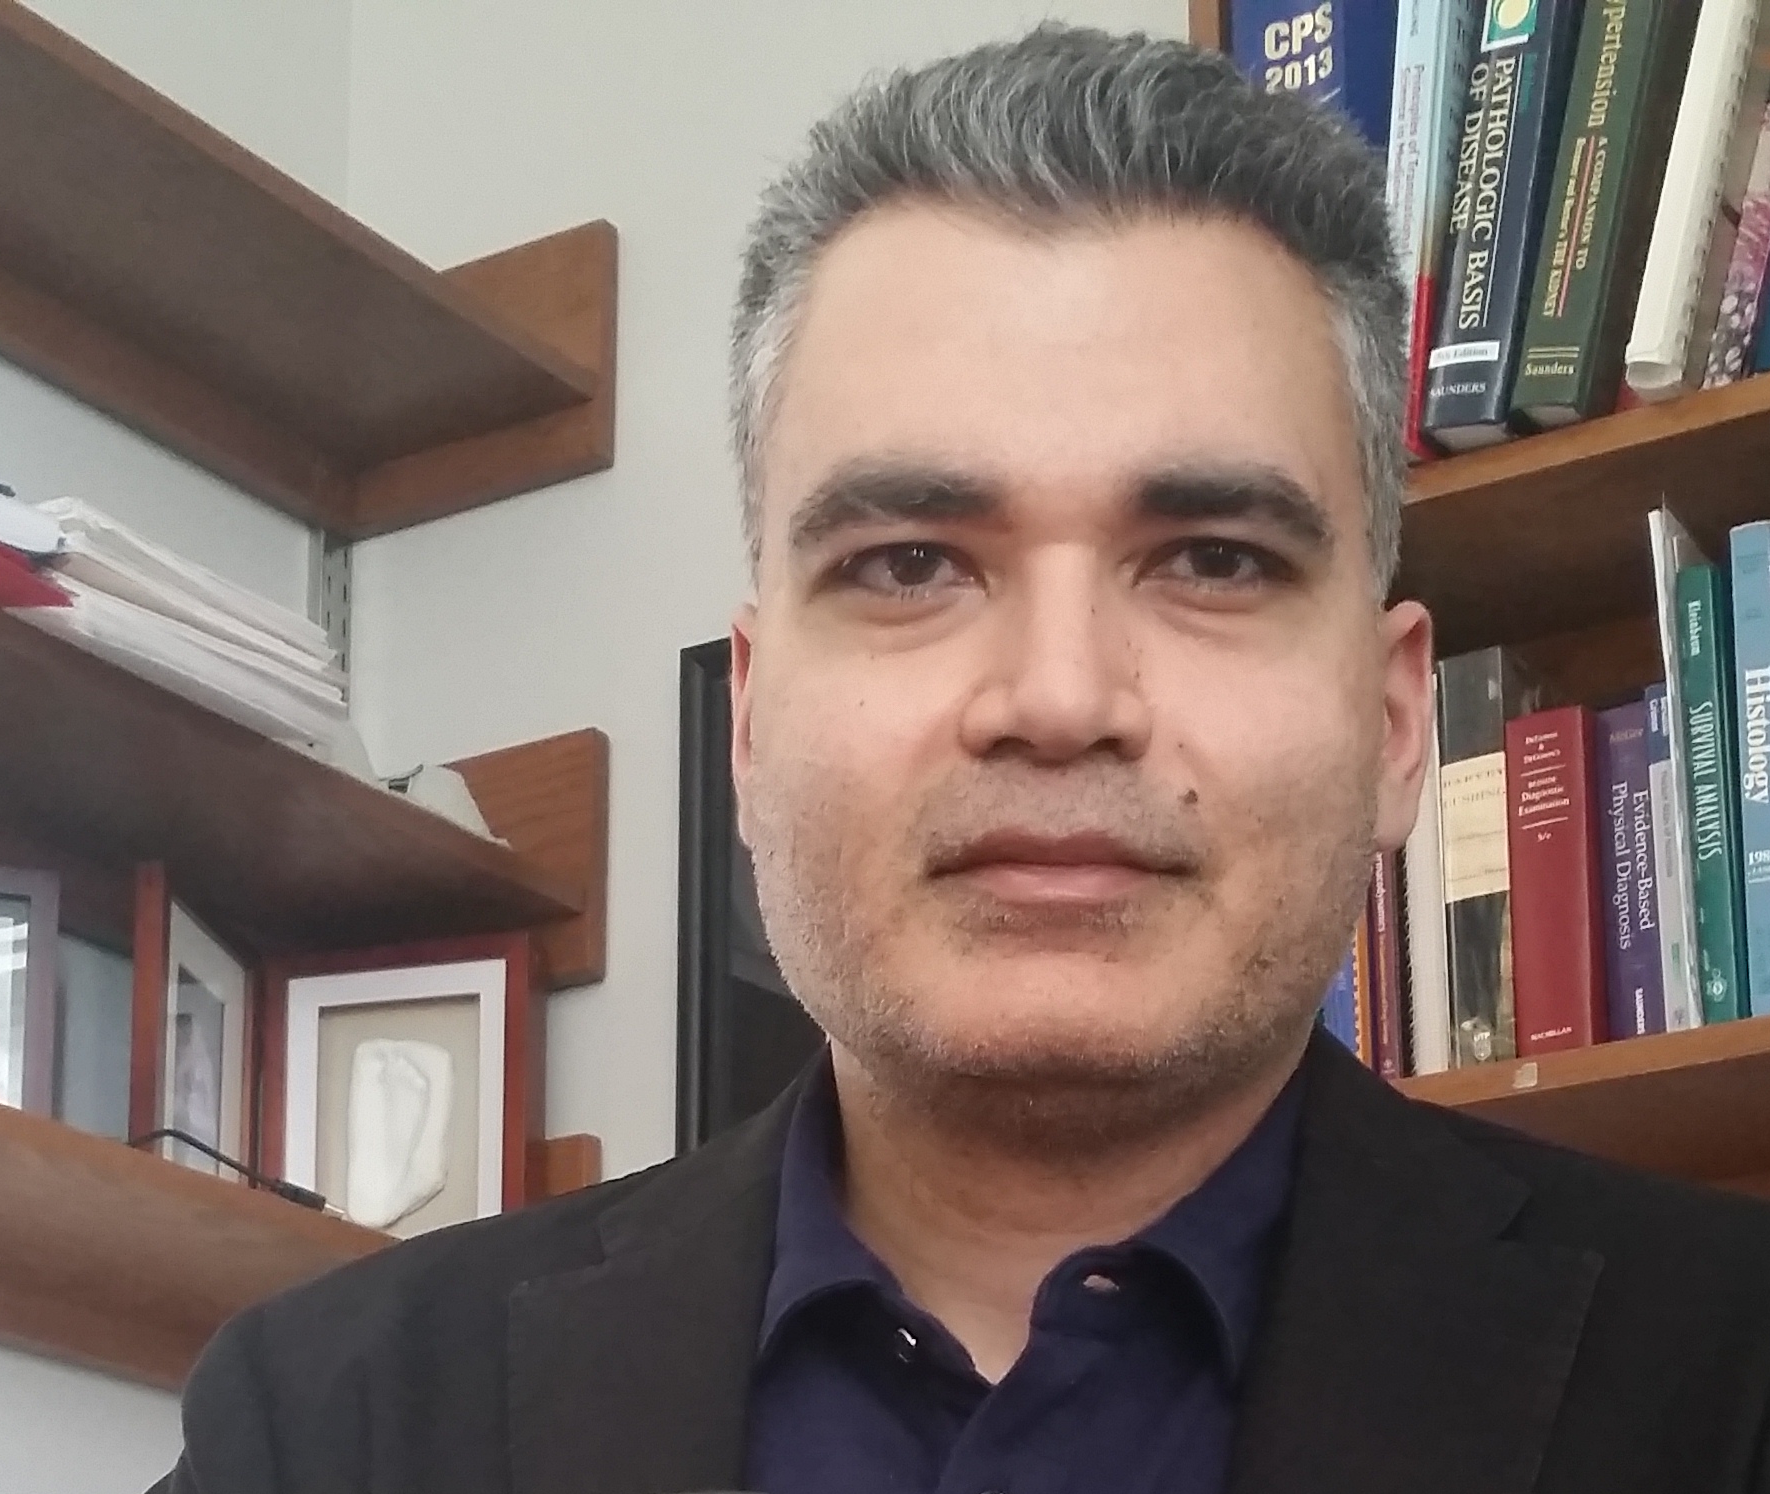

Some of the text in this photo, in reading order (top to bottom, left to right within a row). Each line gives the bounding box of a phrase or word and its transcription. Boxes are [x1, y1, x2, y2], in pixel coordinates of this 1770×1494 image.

[1264, 3, 1333, 60] CPS
[1265, 46, 1333, 95] 2013
[1469, 62, 1489, 102] OF
[1449, 107, 1485, 235] DISEASE
[1458, 56, 1516, 330] PATHOLOGIC BASIS
[1575, 246, 1589, 270] TO
[1525, 361, 1574, 377] Saunders
[1689, 700, 1724, 862] SURVIVAL ANALYSIS
[1611, 781, 1632, 951] Physical Diagnosis
[1632, 789, 1656, 931] Evidence-Based
